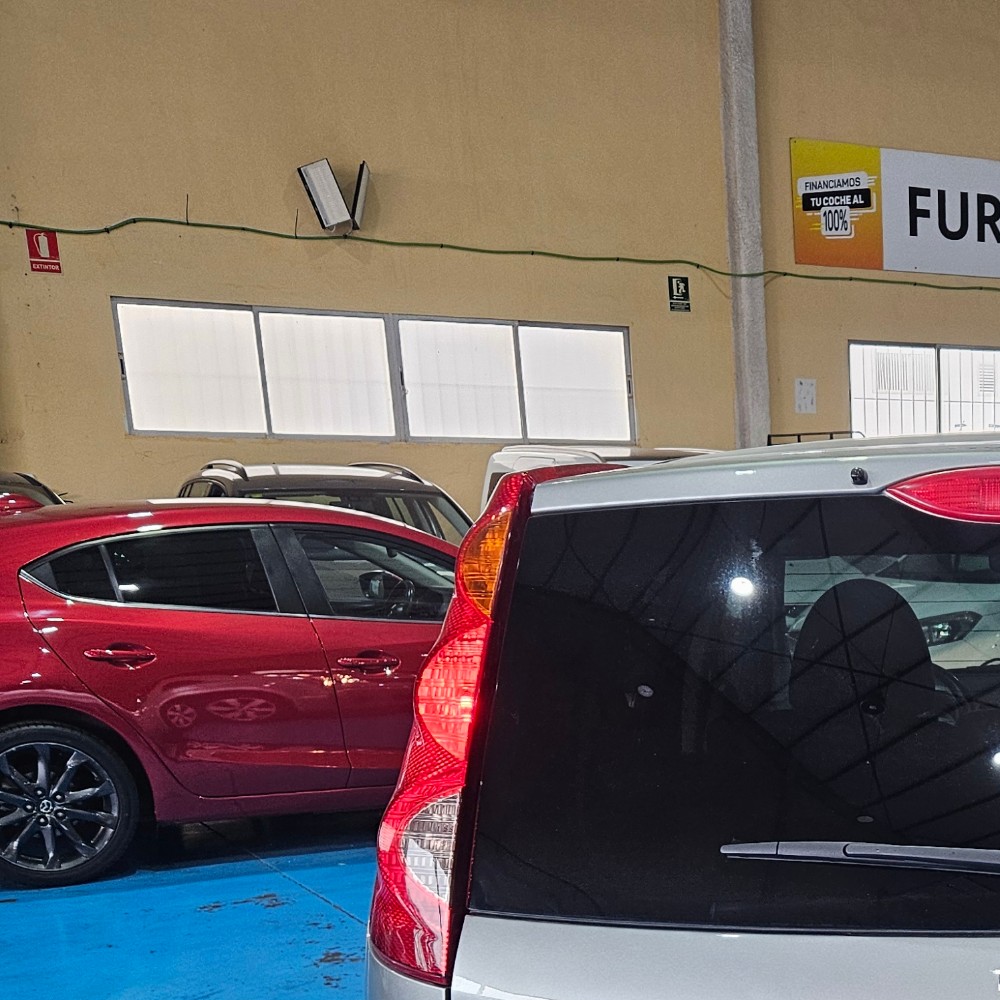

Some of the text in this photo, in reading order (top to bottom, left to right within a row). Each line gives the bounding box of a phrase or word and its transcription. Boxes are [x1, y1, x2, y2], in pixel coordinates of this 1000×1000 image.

[804, 177, 861, 191] FINANCIAMOS
[810, 194, 865, 207] TU COCHE AL
[823, 209, 848, 232] 100%
